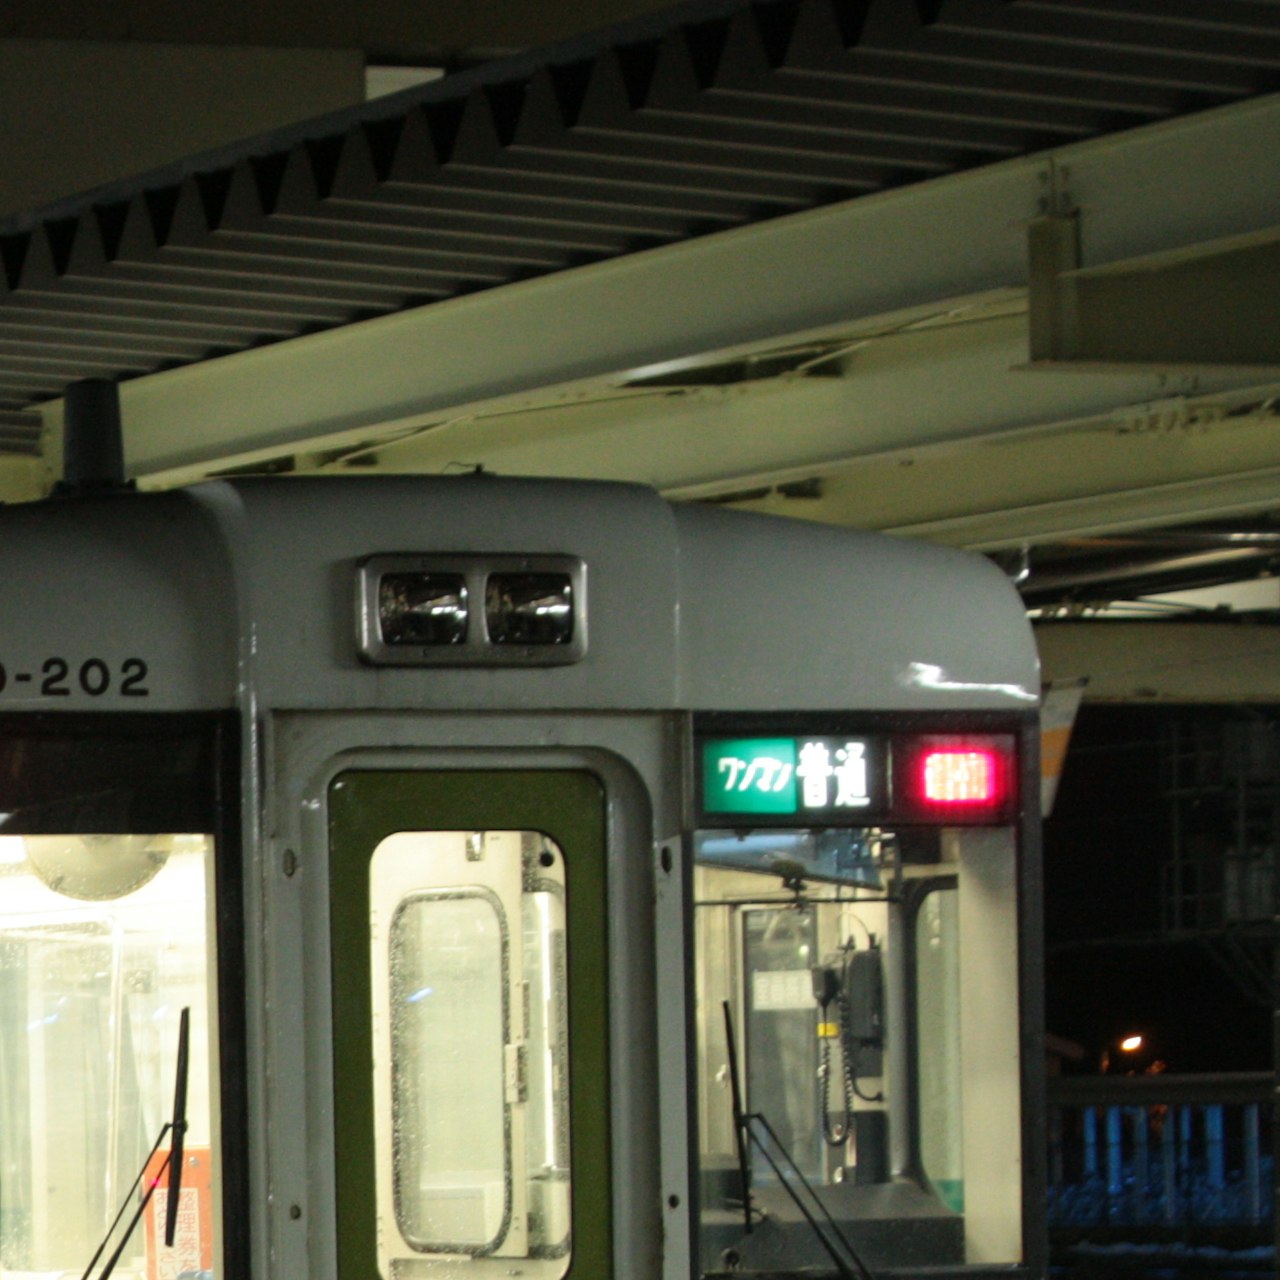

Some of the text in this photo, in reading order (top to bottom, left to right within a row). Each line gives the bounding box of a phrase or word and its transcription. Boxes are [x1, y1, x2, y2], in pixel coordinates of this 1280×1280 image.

[718, 742, 871, 808] ワンマン 普通
